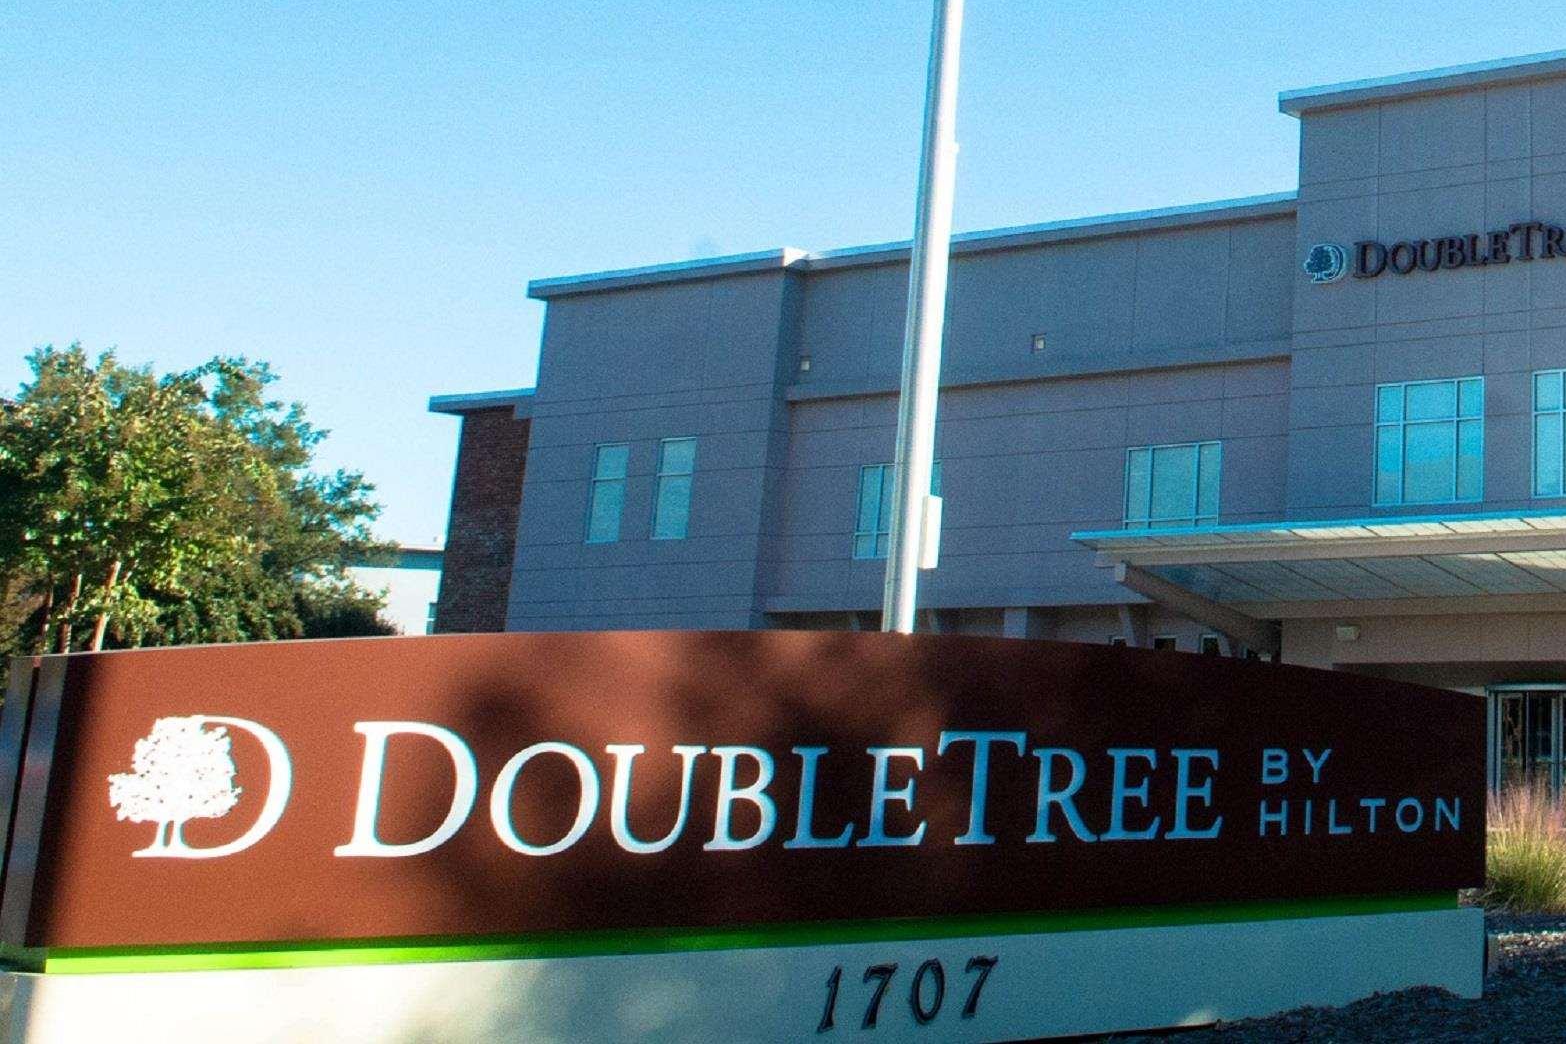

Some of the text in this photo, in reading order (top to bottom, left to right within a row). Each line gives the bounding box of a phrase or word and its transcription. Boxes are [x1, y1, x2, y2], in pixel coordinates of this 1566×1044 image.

[333, 720, 1223, 857] DOUBLETREE
[1260, 747, 1333, 786] BY
[1258, 797, 1463, 837] HILTON
[816, 957, 999, 1034] 1707
